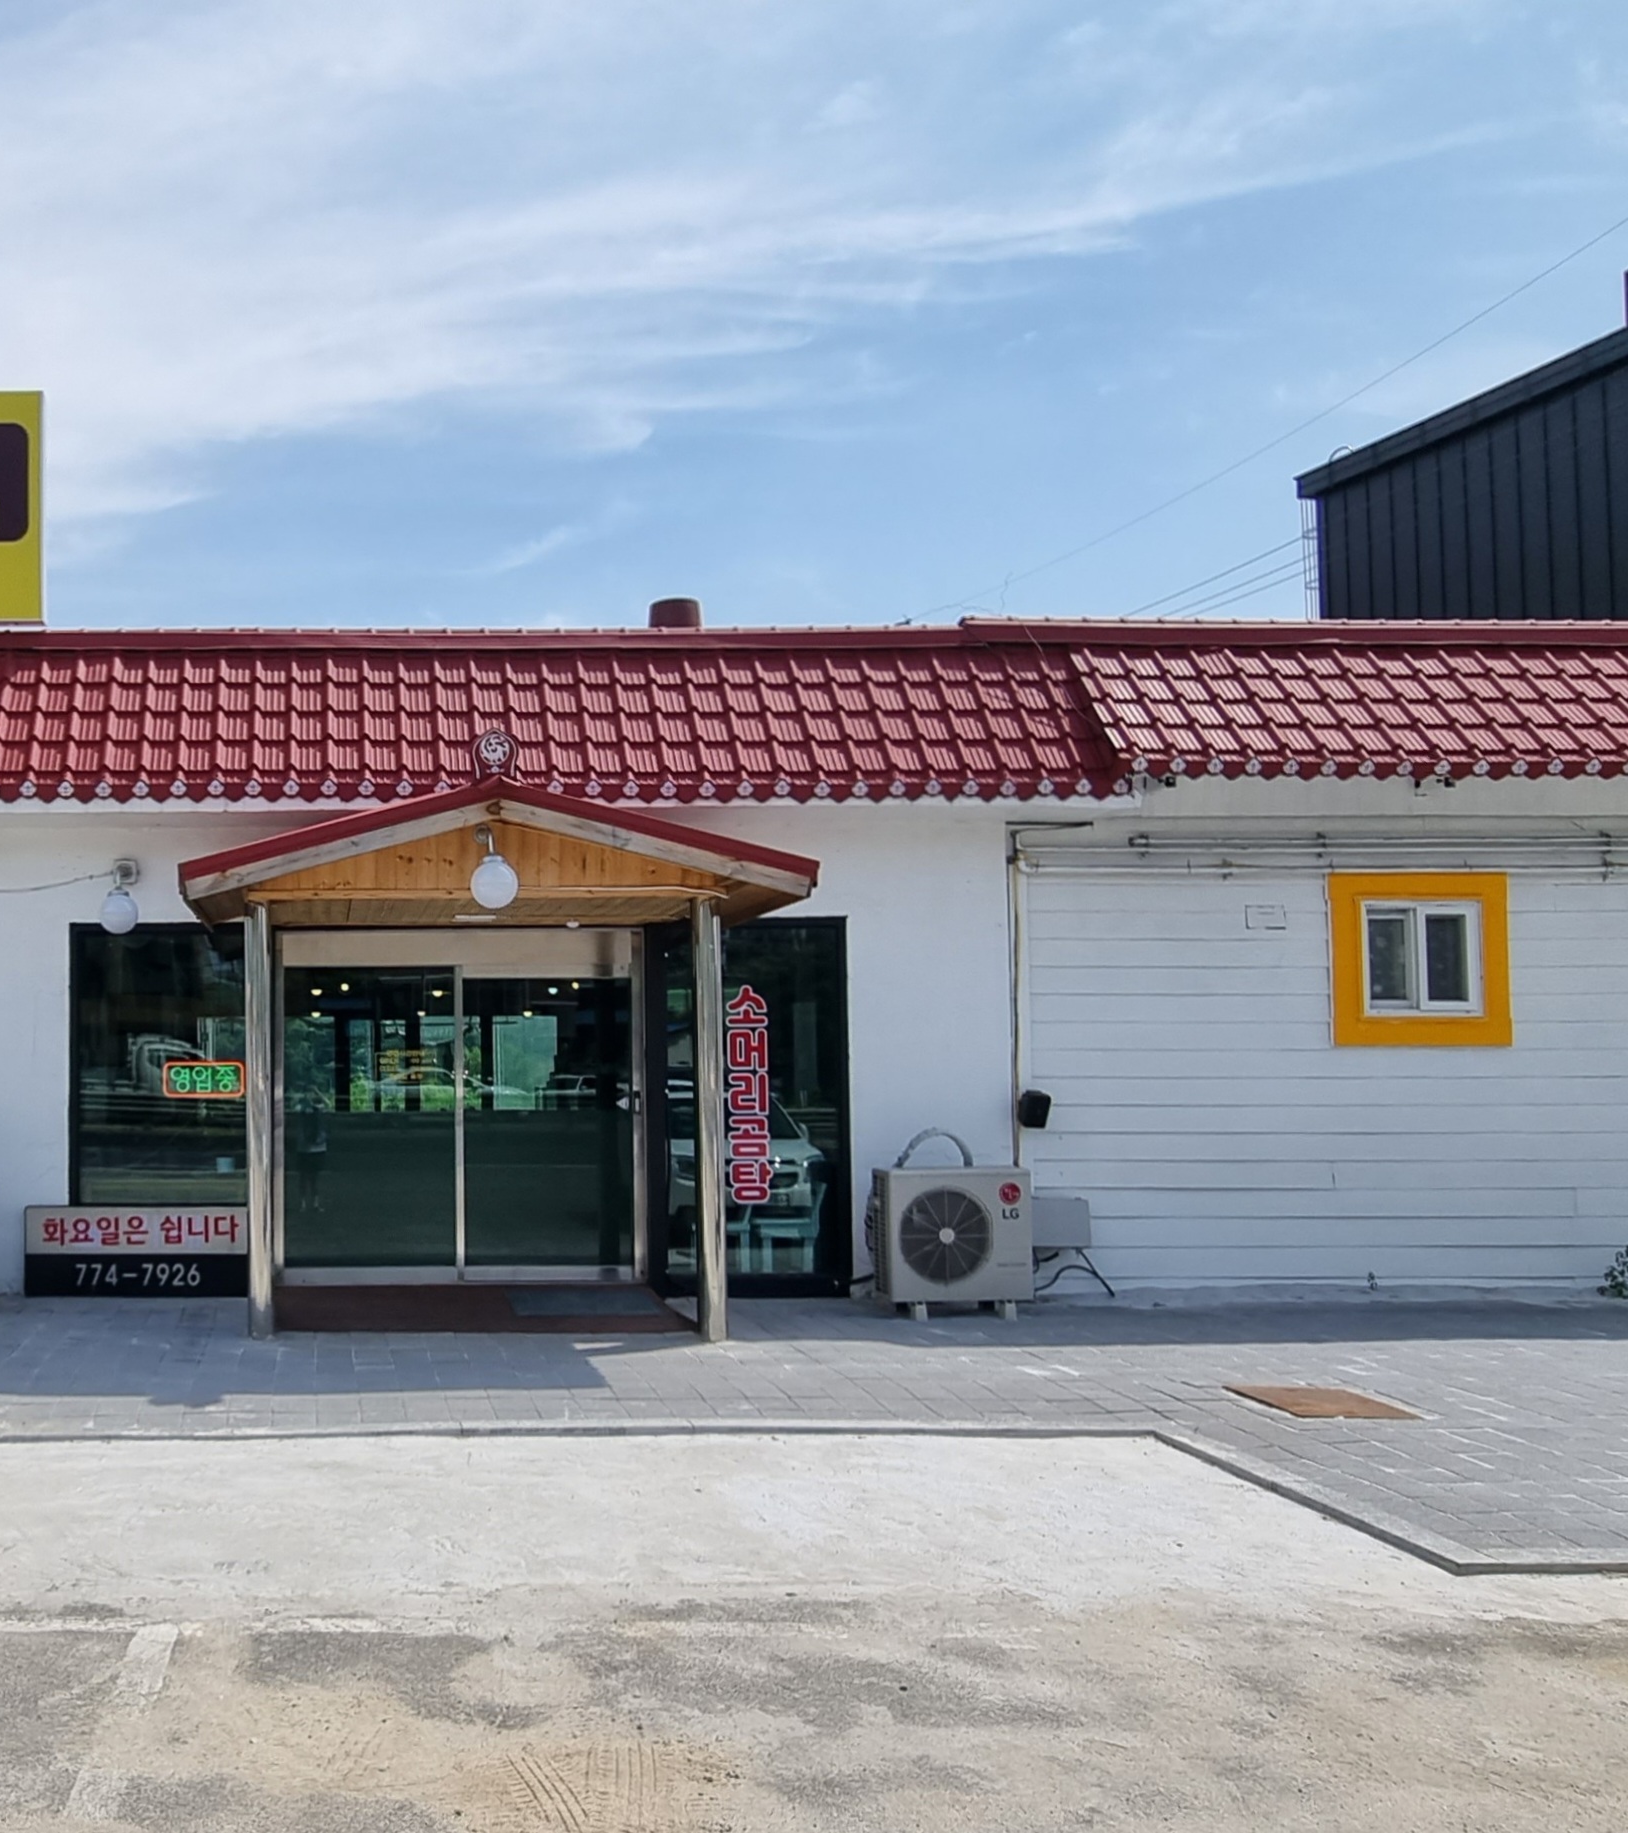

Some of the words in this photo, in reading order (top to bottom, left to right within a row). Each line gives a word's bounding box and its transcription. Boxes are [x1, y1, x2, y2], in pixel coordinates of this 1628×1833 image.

[170, 1066, 238, 1093] 영업중
[726, 984, 774, 1204] 소머리곰탕
[1002, 1208, 1020, 1220] LG
[42, 1216, 149, 1246] 화요일은
[160, 1215, 240, 1244] 쉽니다
[75, 1263, 201, 1287] 774-7926
